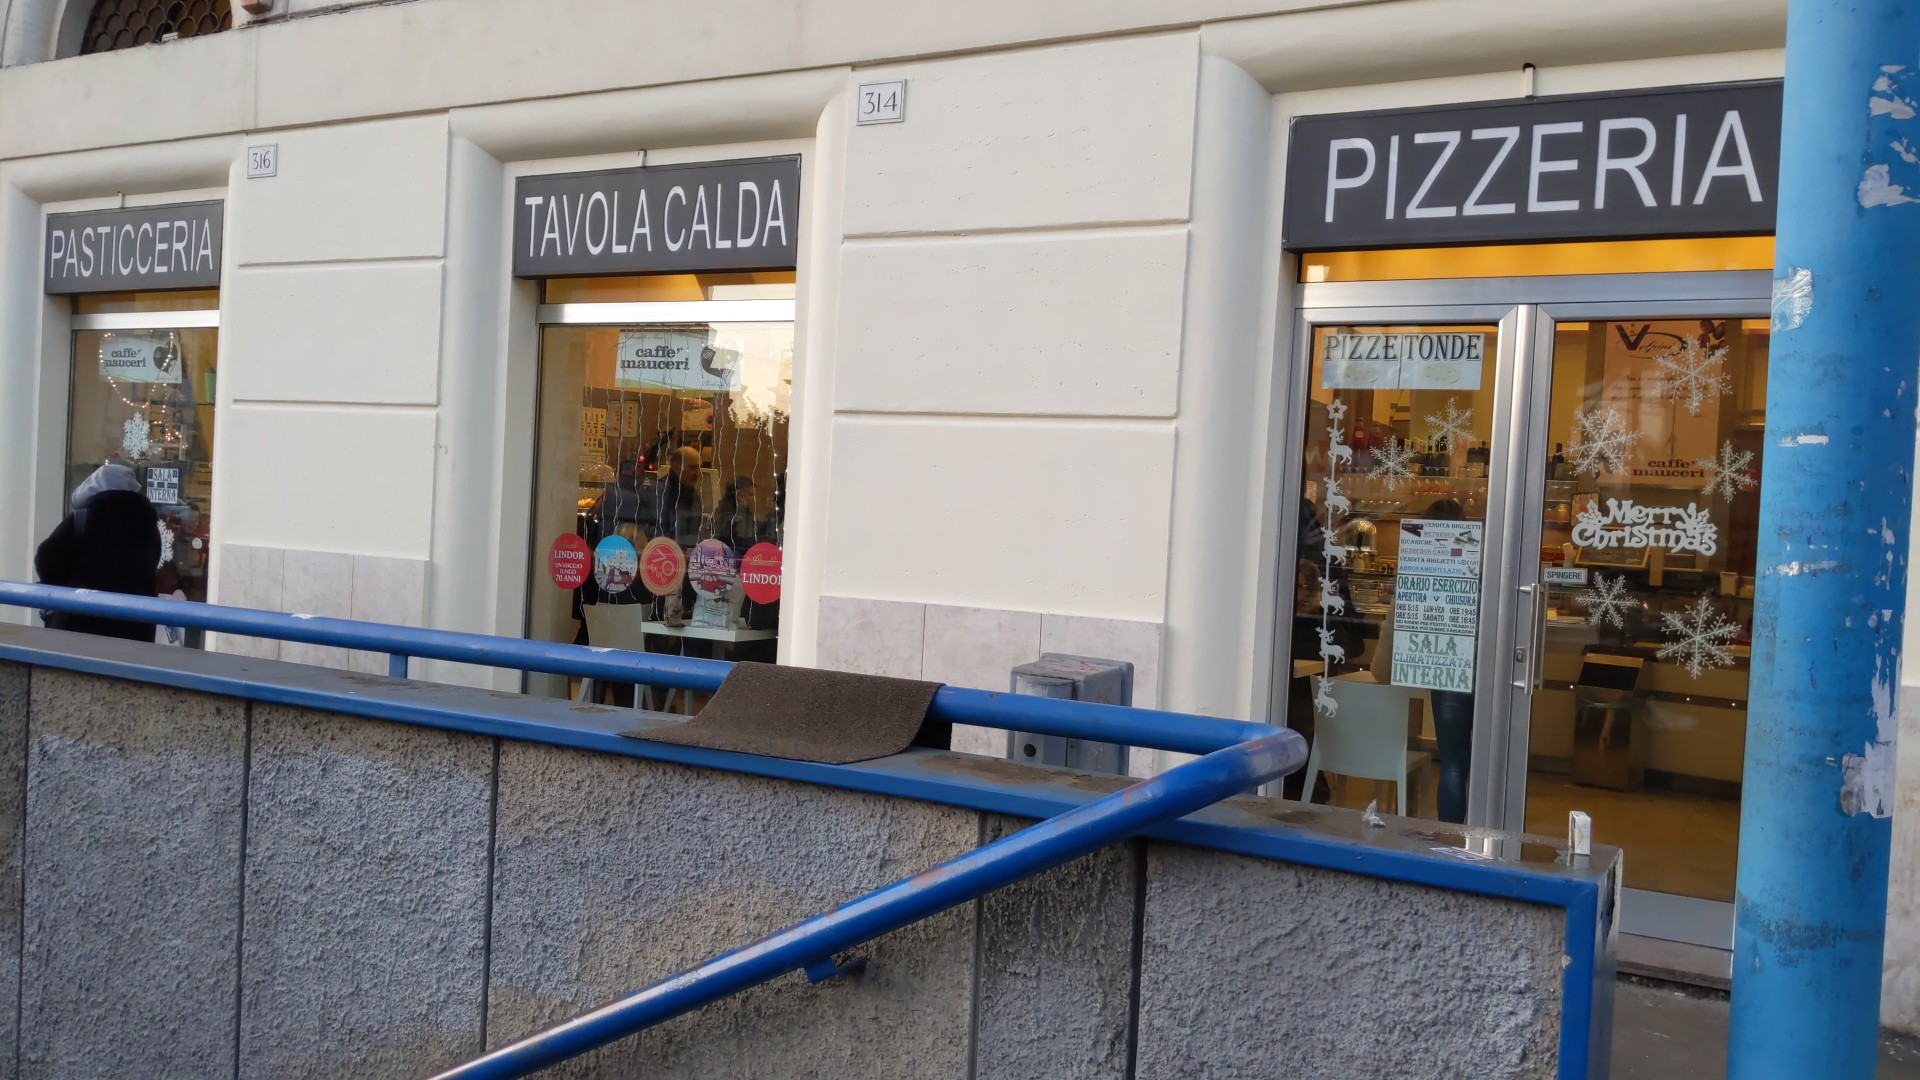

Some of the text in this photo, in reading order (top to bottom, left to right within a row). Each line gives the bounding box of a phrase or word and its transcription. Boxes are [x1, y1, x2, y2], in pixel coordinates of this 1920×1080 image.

[863, 91, 898, 114] 314
[251, 150, 271, 170] 316
[1325, 110, 1763, 222] PIZZERIA
[525, 179, 787, 257] TAVOLA CALDA
[50, 218, 213, 278] PASTICCERIA
[1324, 335, 1481, 361] PIZZE TONDE
[104, 357, 147, 368] mauceri
[621, 358, 690, 370] mauceri
[153, 469, 172, 481] SALA
[1632, 469, 1704, 477] mauceri
[147, 488, 176, 502] INTERNA
[1603, 498, 1697, 536] Merry
[1571, 521, 1718, 556] Christmas
[554, 550, 584, 560] LINDOR
[1546, 571, 1582, 580] SPINGERE
[1397, 576, 1478, 595] ORARIO ESERCIZIO
[1397, 591, 1477, 606] APERTURA CHIUSURA
[1396, 603, 1406, 611] ORE
[1424, 605, 1445, 614] LUN-VEN
[1450, 607, 1460, 615] ORE
[1461, 608, 1476, 616] 19:45
[1423, 613, 1445, 622] SABATO
[1449, 615, 1460, 623] ORE
[1461, 616, 1476, 625] 16:45
[1408, 632, 1458, 656] SALA
[1393, 652, 1472, 669] CLIMATIZZATA
[1392, 663, 1470, 689] INTERNA
